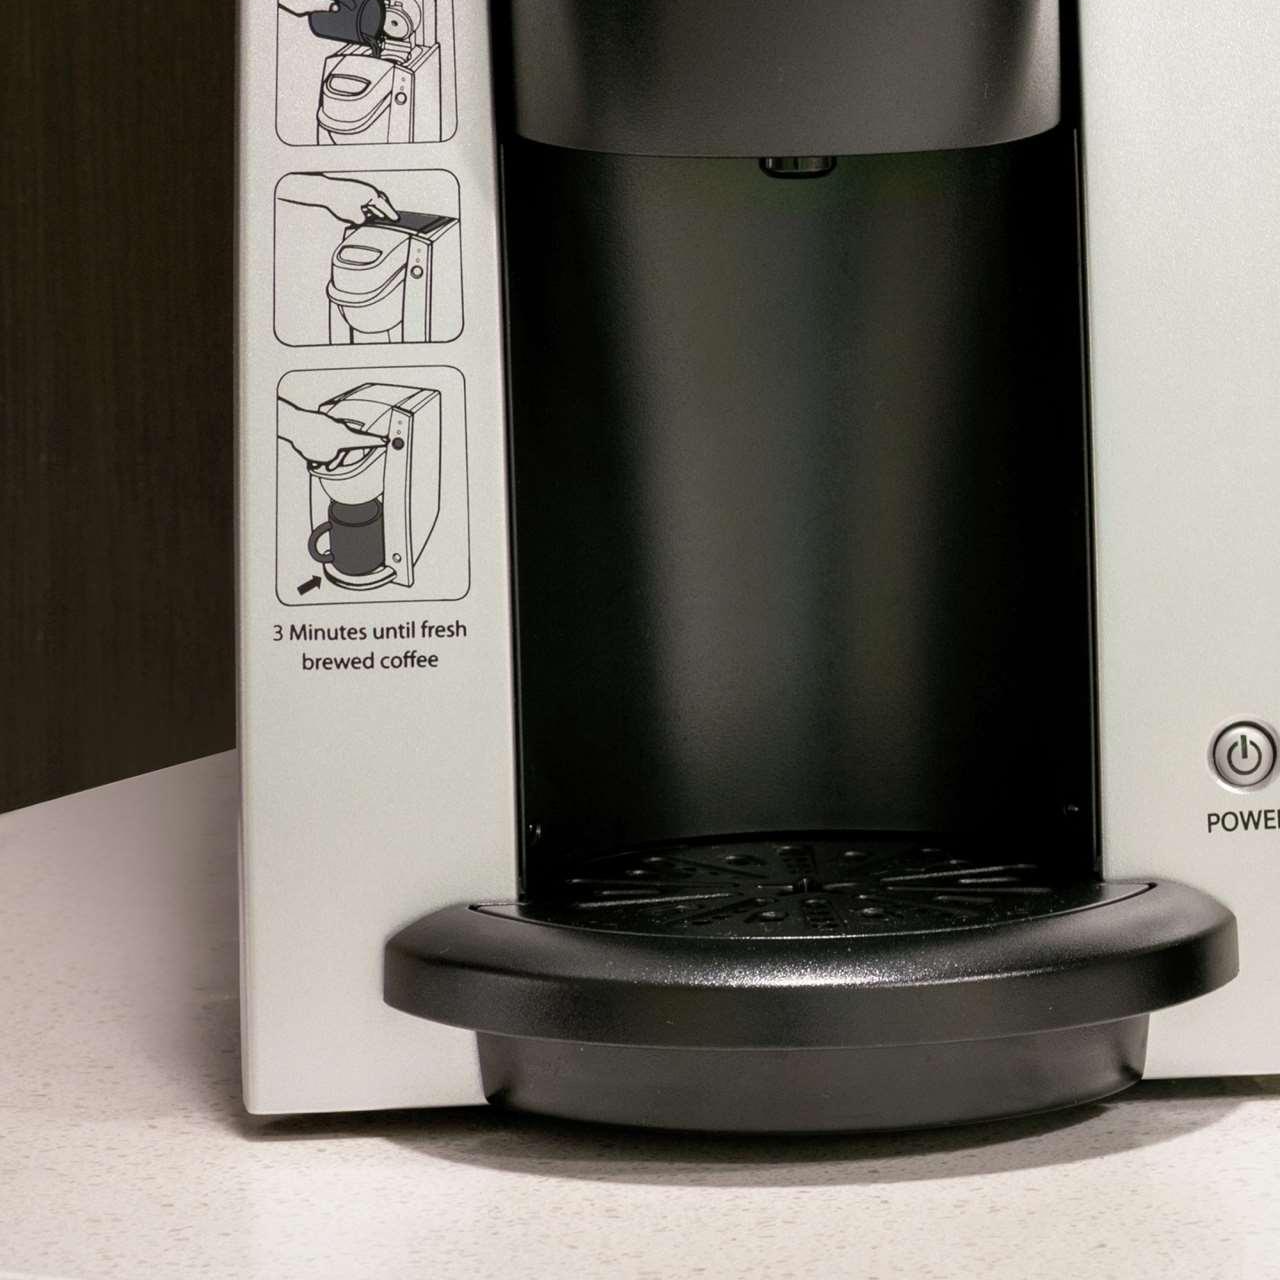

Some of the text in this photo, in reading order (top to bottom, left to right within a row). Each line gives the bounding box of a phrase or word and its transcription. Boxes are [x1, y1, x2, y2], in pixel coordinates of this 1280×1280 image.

[272, 619, 467, 641] 3 Minutes until fresh
[302, 650, 439, 670] brewed coffee
